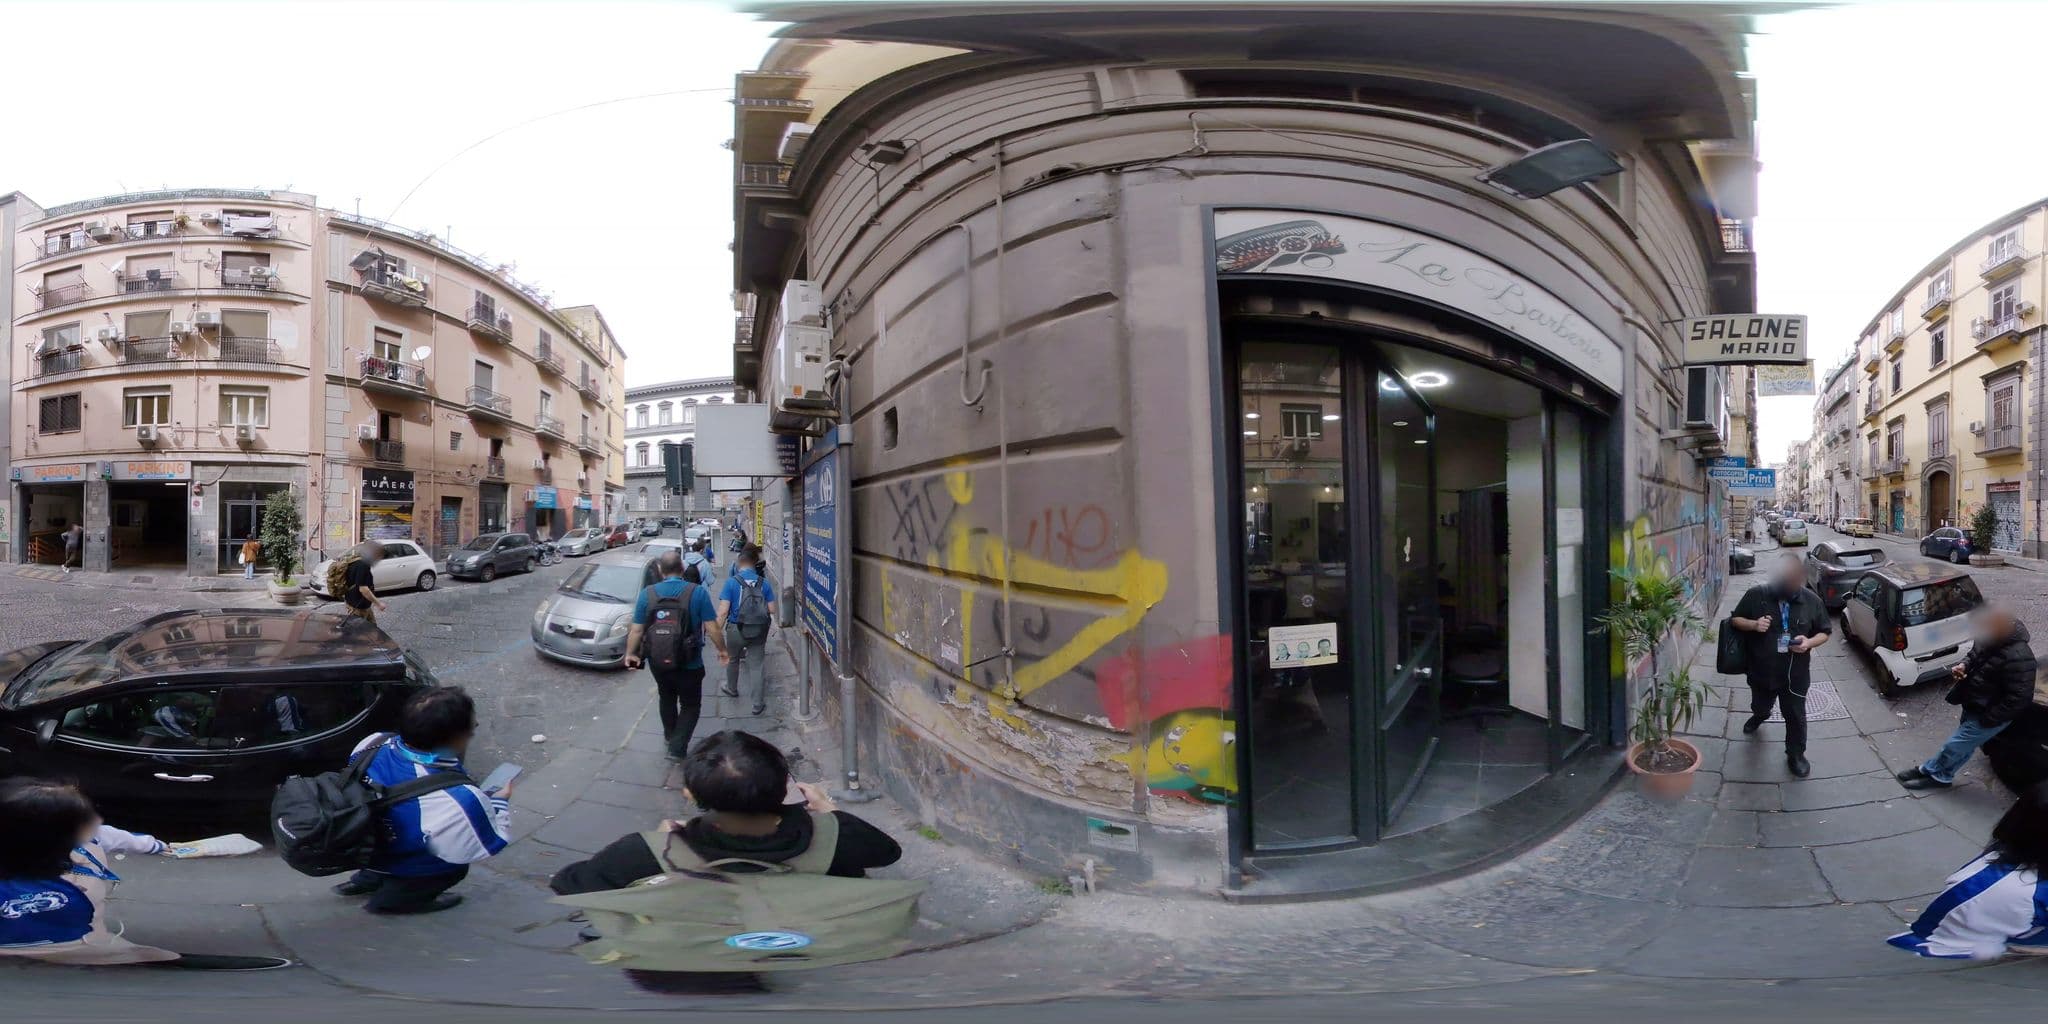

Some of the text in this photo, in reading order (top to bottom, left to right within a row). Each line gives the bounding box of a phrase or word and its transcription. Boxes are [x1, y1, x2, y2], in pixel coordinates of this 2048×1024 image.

[1358, 237, 1456, 287] La
[1691, 318, 1801, 341] SALONE
[1721, 342, 1796, 355] MARIO
[34, 465, 81, 477] PARKING
[128, 462, 185, 475] PARKING
[1749, 472, 1771, 484] Print
[807, 561, 830, 591] Anonimi
